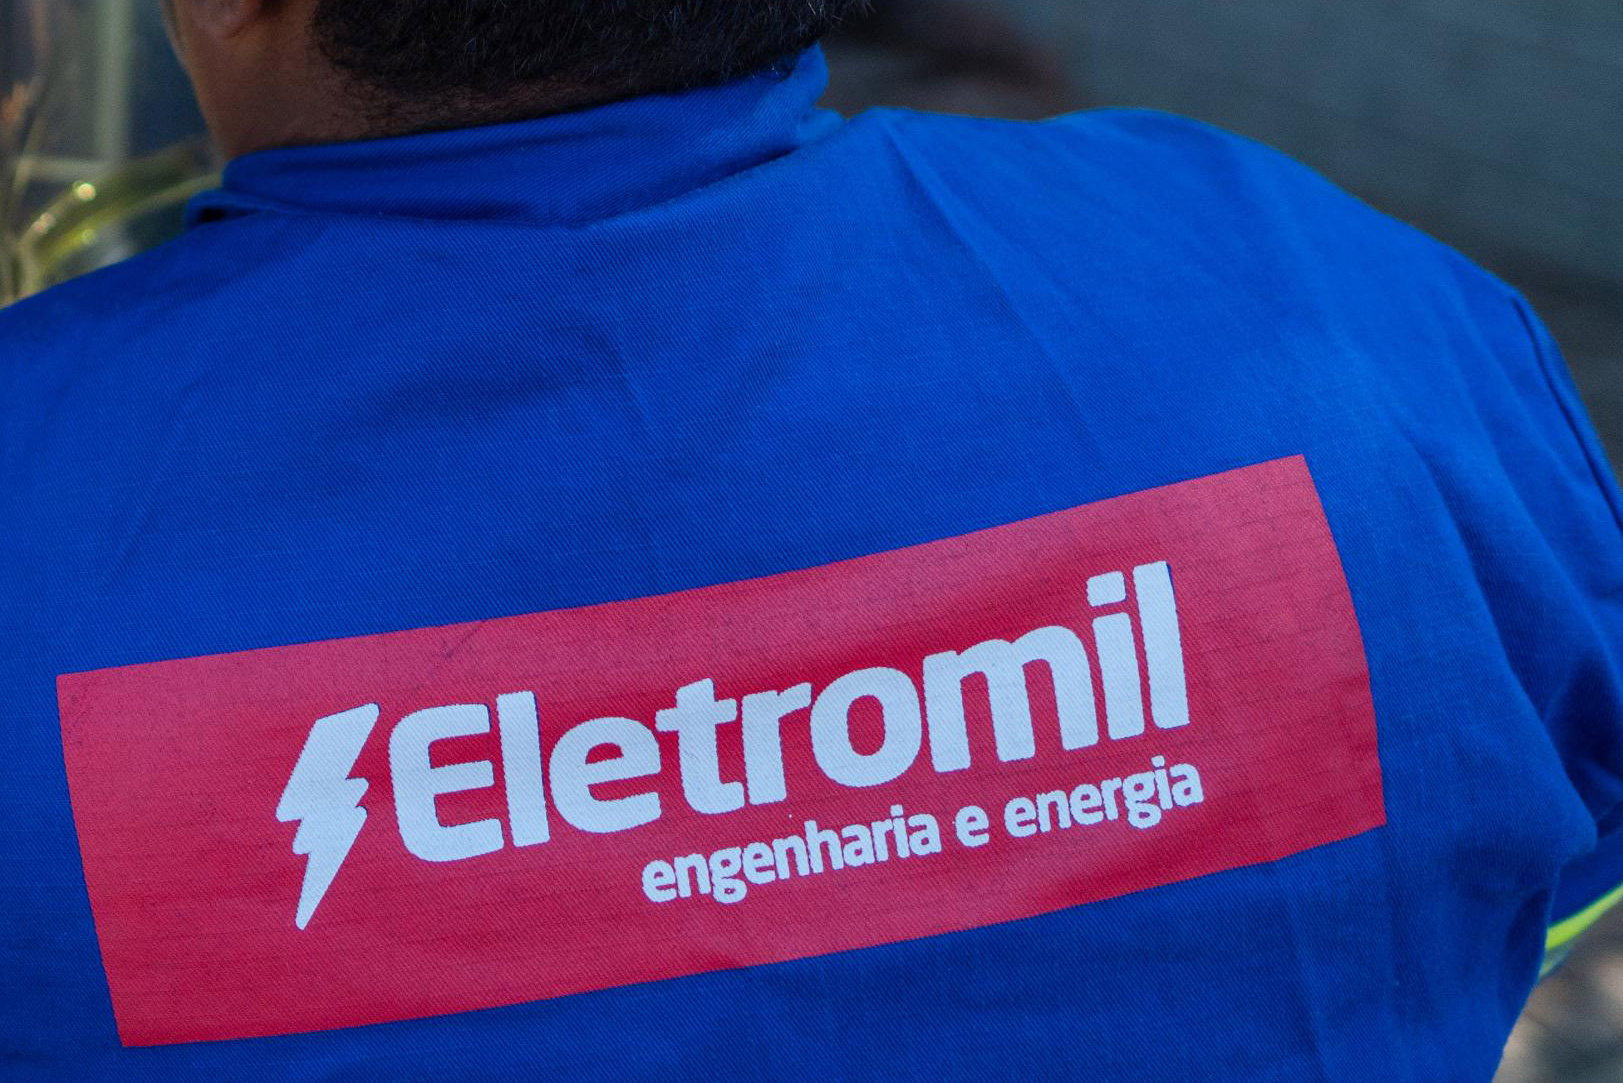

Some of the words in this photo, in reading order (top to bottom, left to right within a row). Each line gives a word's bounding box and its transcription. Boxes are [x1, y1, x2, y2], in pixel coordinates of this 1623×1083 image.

[389, 561, 1191, 863] Eletromil
[642, 805, 942, 904] engenharia
[953, 805, 990, 848] e
[1004, 756, 1205, 830] energia
